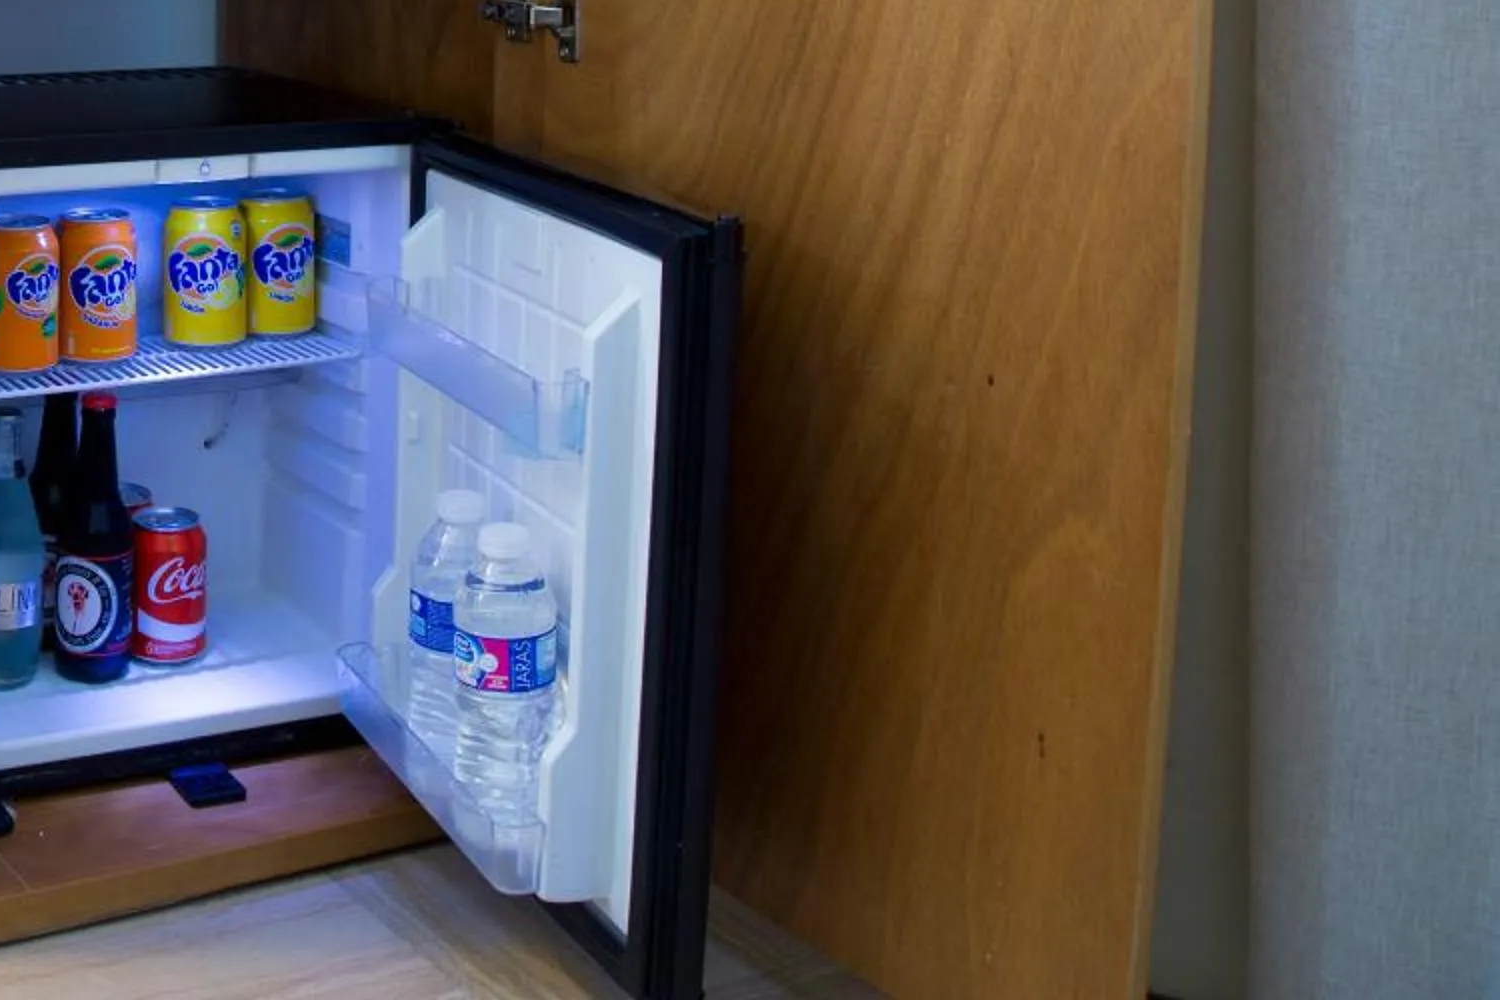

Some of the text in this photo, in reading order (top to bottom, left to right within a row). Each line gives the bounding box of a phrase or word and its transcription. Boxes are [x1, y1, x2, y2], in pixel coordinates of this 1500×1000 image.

[167, 246, 239, 293] Fanta
[252, 235, 315, 284] Fant
[7, 264, 59, 304] Fant
